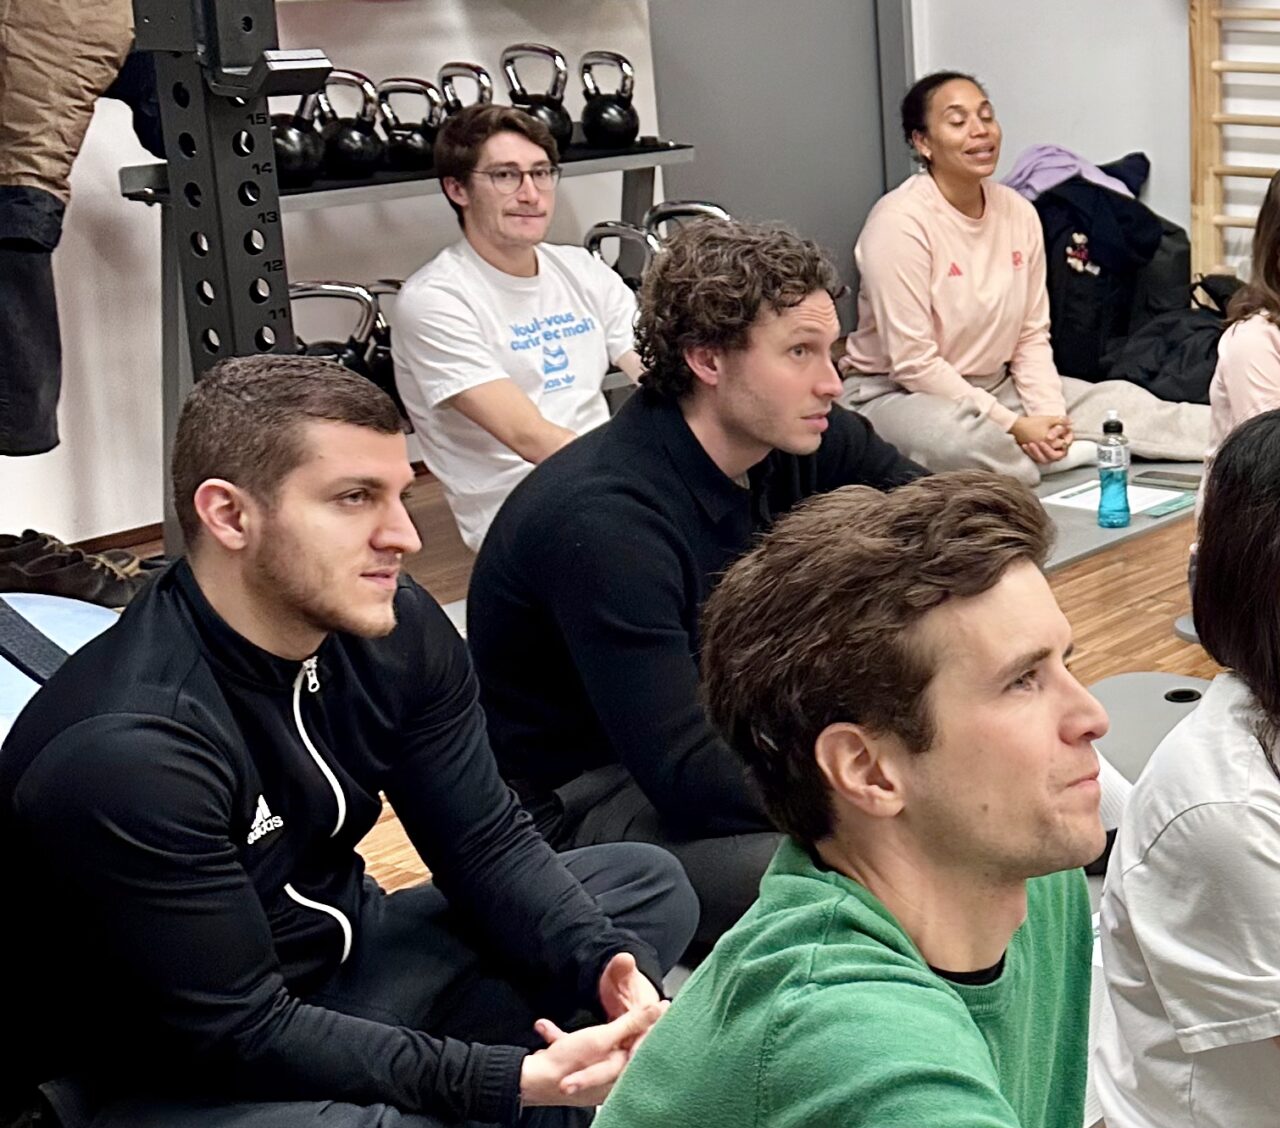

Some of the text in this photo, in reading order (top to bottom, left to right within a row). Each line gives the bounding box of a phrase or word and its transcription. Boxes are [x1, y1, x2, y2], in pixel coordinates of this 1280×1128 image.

[246, 112, 268, 125] 15
[252, 162, 273, 175] 14
[258, 211, 278, 224] 13
[263, 260, 284, 272] 12
[268, 307, 287, 320] 11
